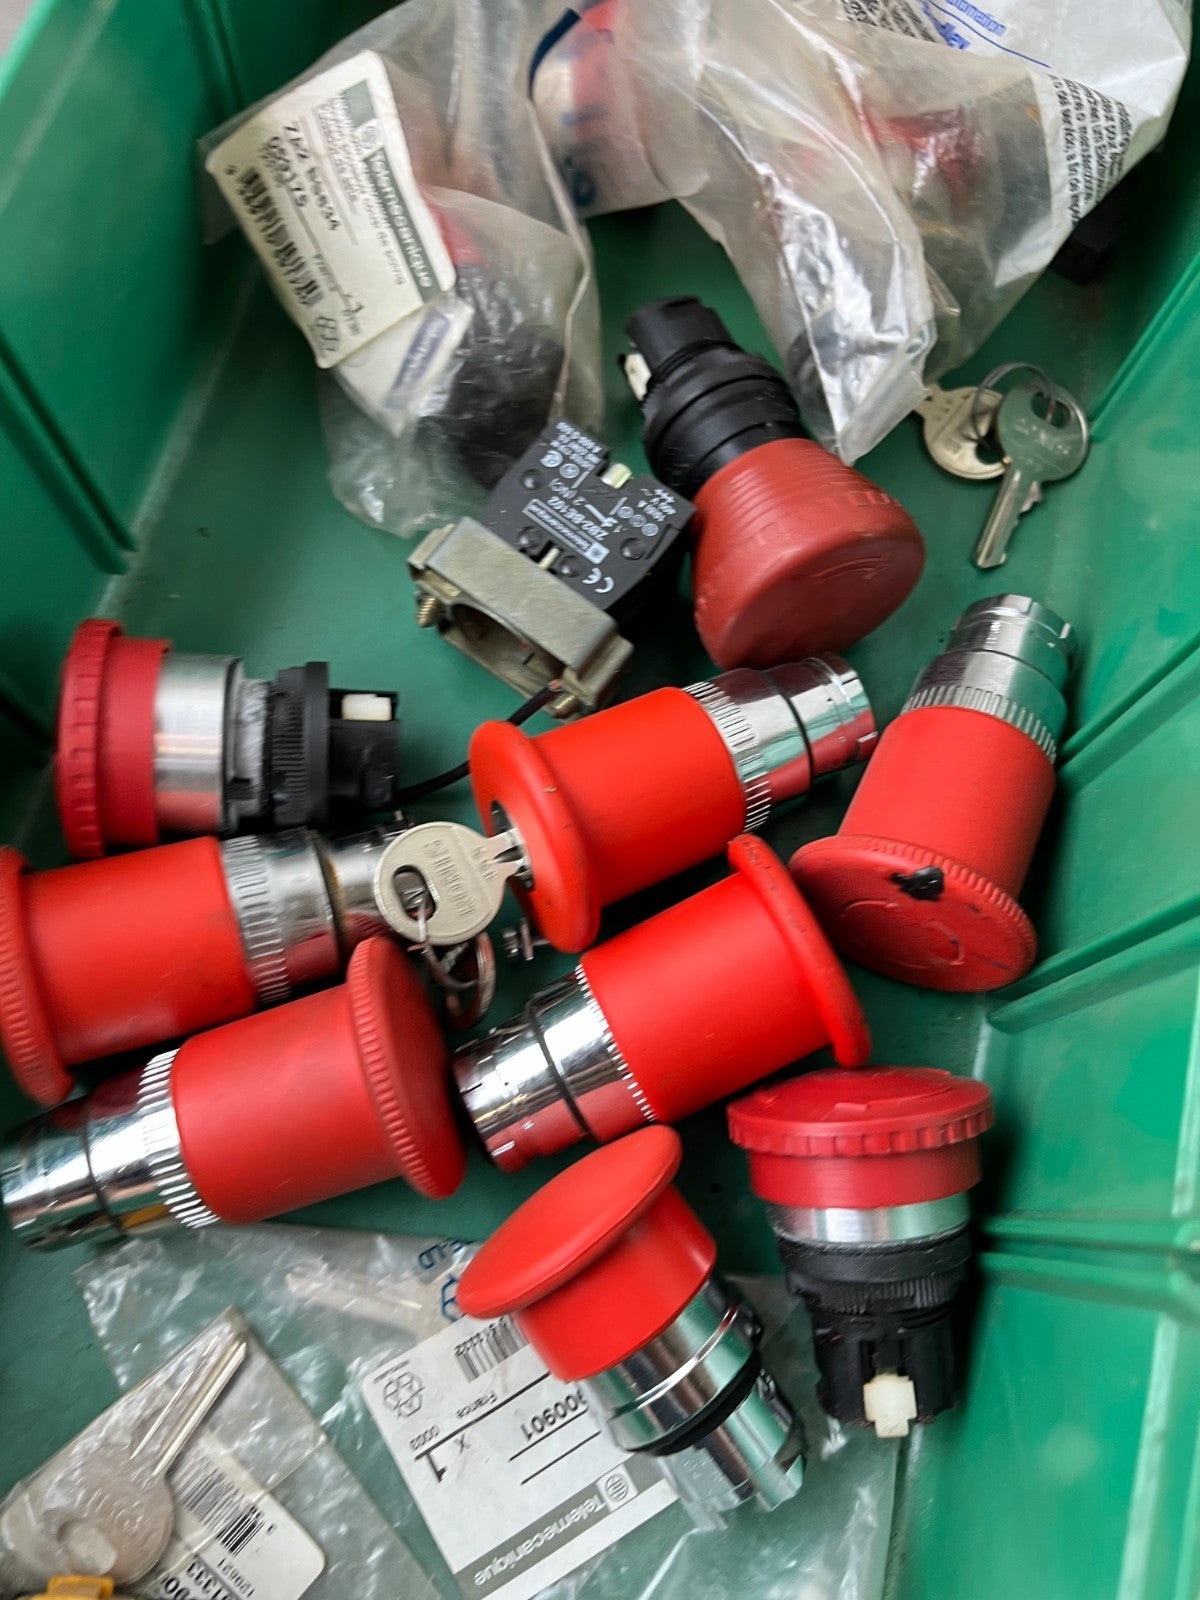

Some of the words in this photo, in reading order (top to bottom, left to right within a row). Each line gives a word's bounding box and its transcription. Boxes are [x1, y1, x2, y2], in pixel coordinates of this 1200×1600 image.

[454, 1390, 498, 1420] France
[424, 1448, 450, 1483] 1
[470, 1493, 605, 1588] Telemecanique
